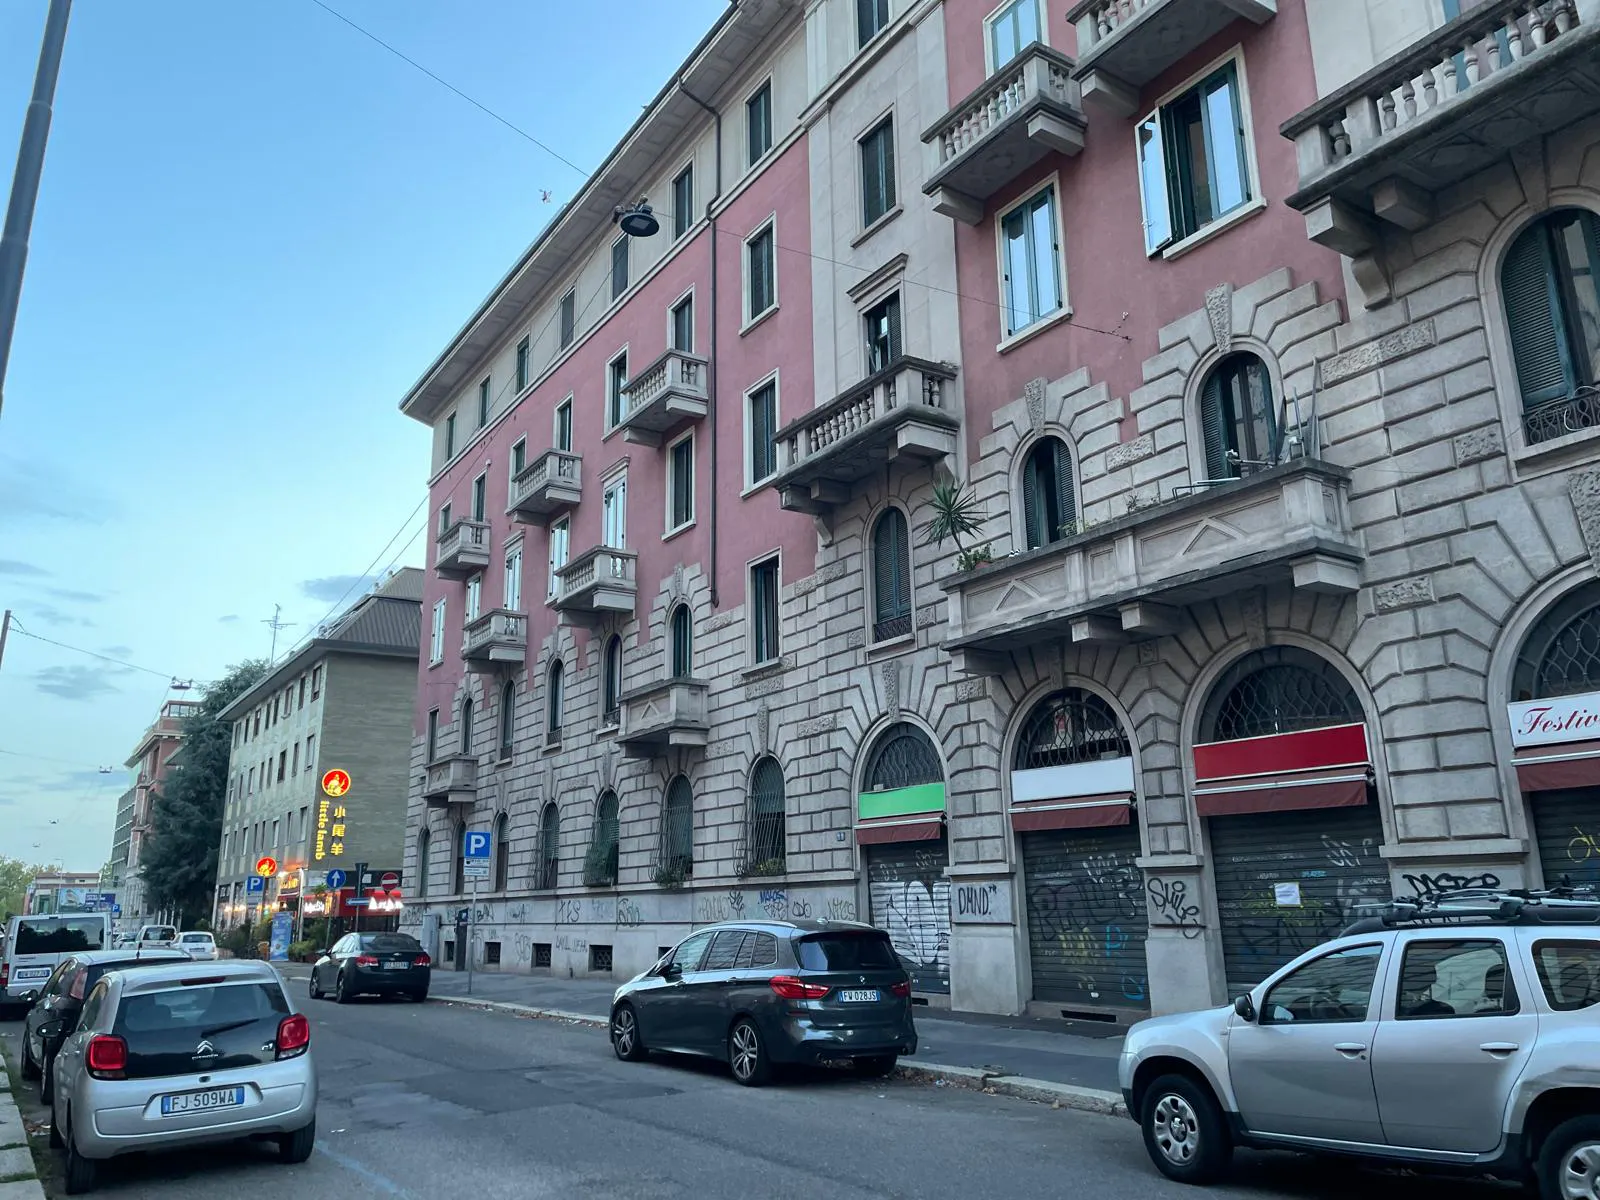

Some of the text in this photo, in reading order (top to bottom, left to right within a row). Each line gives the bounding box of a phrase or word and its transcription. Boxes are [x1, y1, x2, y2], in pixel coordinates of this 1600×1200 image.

[315, 801, 329, 860] little lamb
[331, 805, 346, 855] 小尾羊
[470, 834, 486, 855] P
[250, 877, 261, 890] P
[171, 1091, 235, 1111] FJ 509WA
